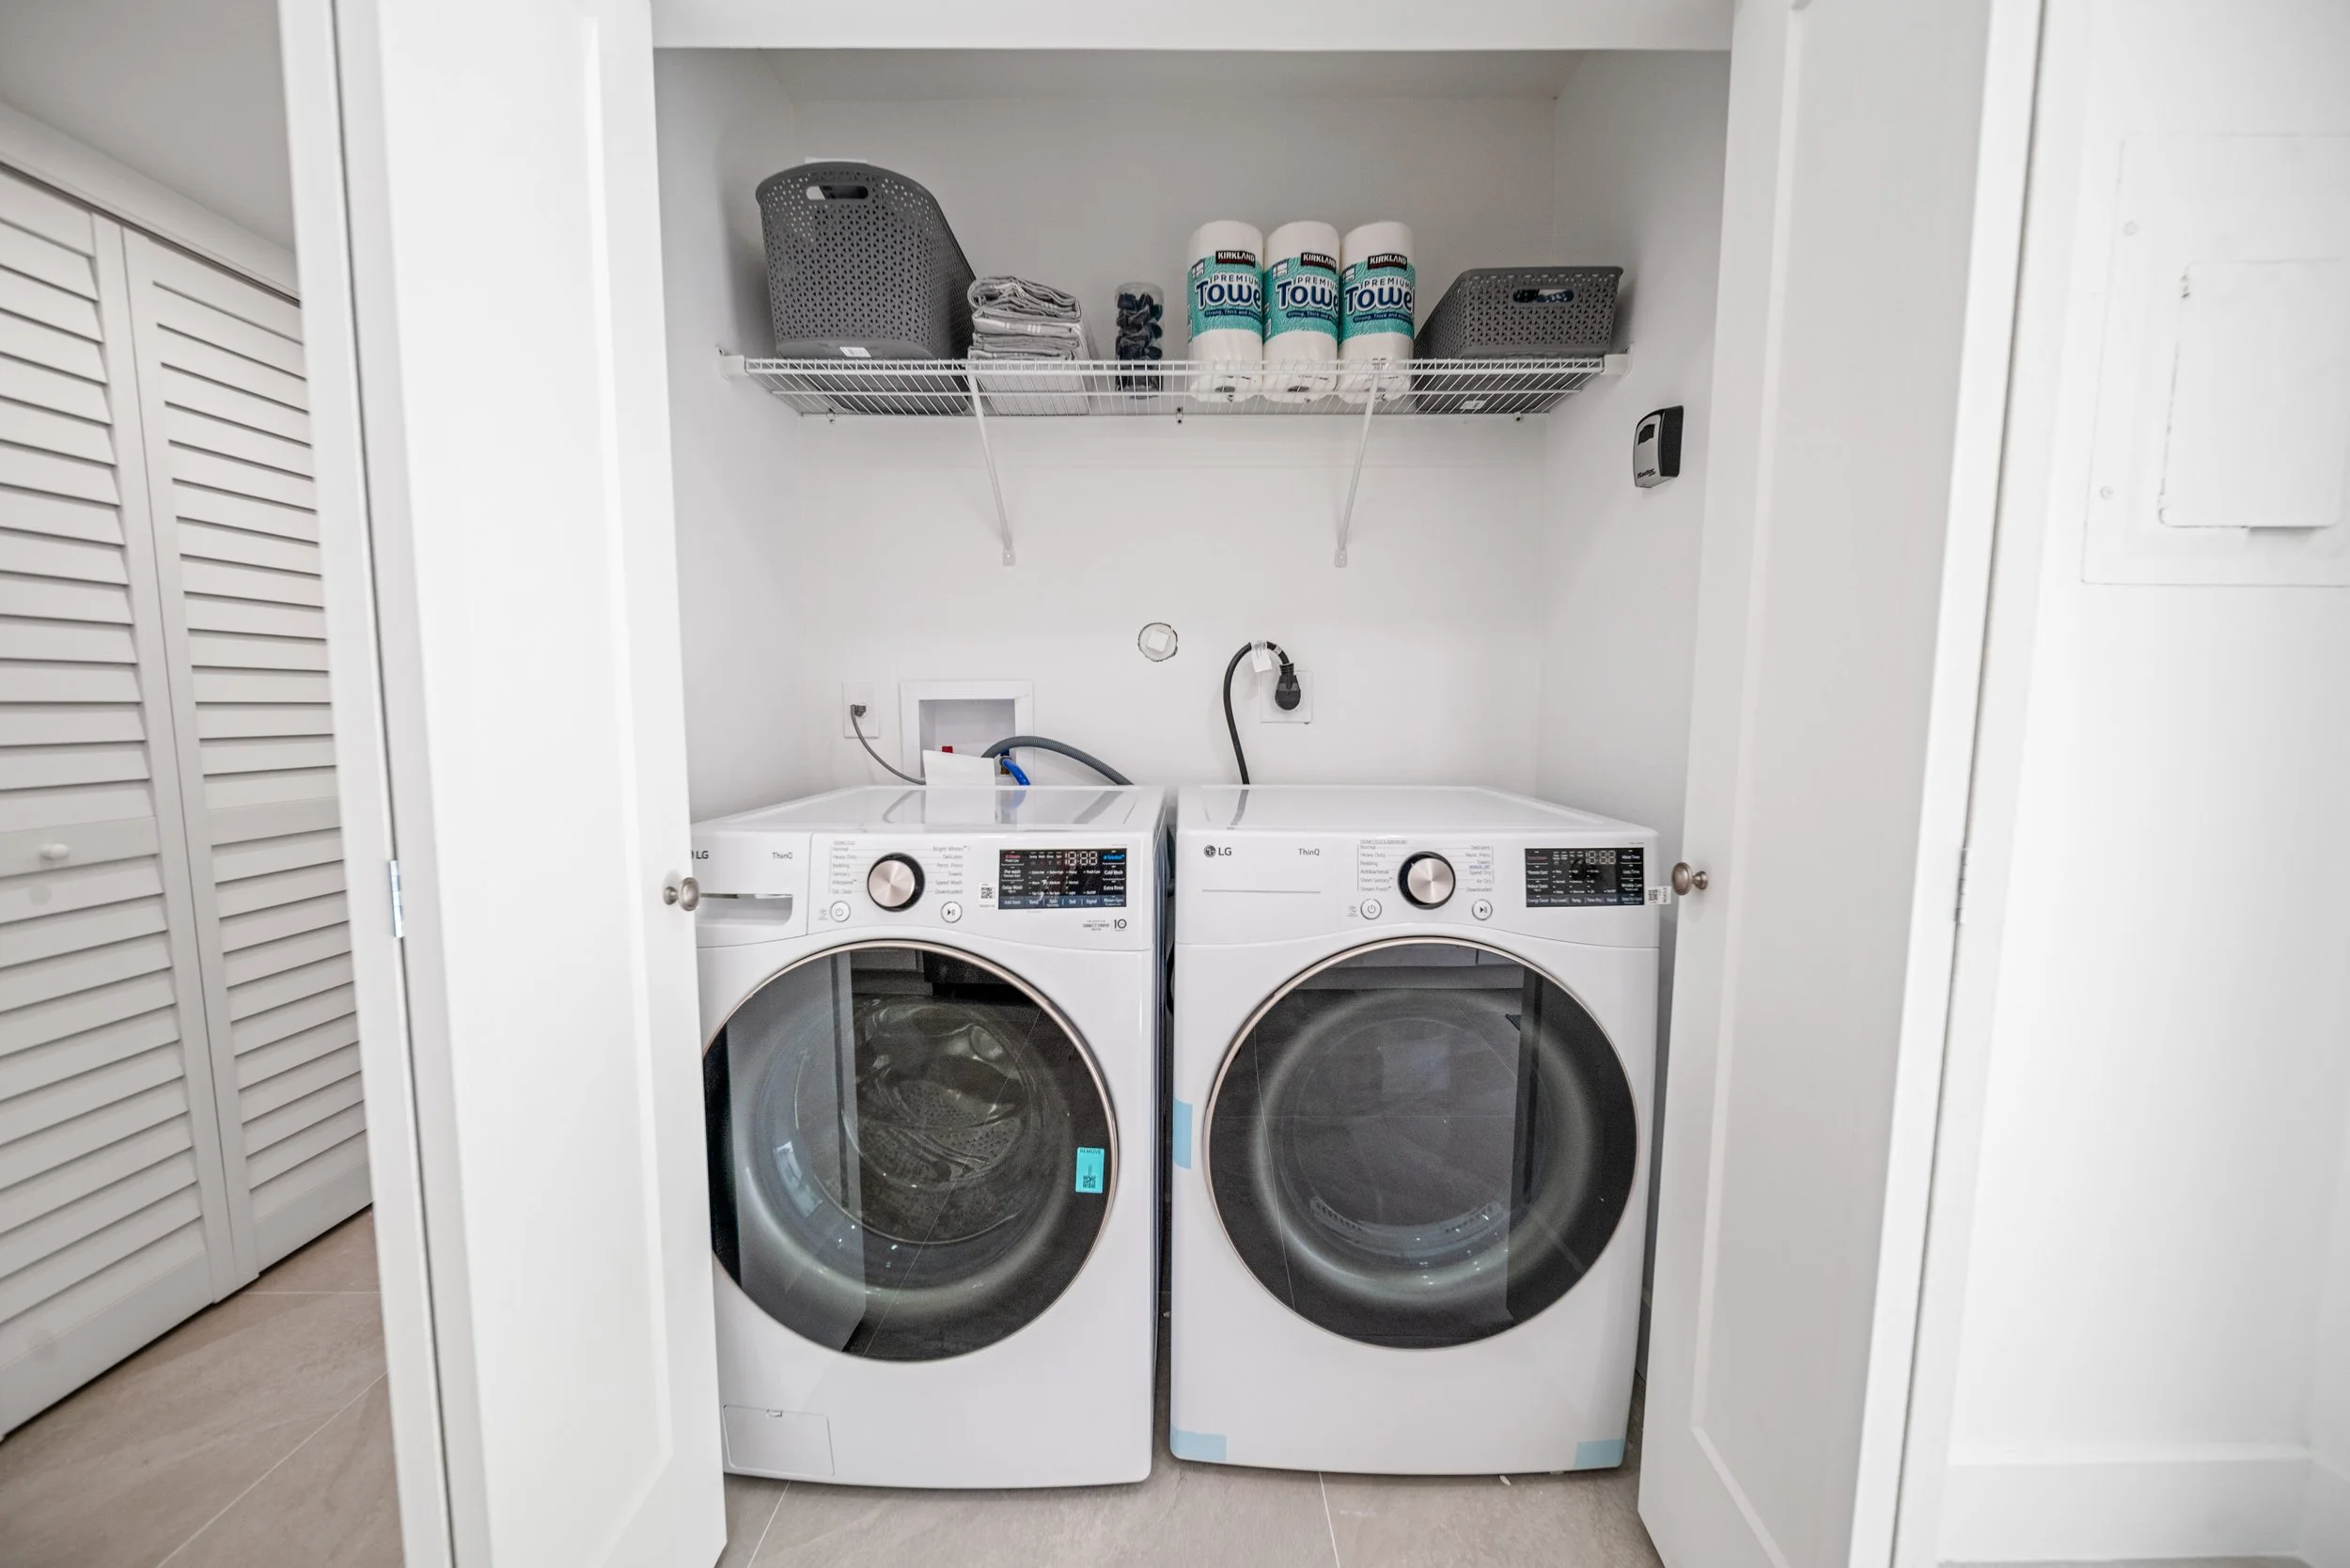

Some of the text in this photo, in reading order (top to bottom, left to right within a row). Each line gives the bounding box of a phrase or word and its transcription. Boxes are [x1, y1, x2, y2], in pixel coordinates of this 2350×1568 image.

[1217, 251, 1255, 262] KIRKLAND
[1303, 253, 1336, 268] KIRKLAND
[1370, 255, 1407, 265] KIRKLAND
[1345, 286, 1415, 313] Towe
[696, 851, 709, 859] LG
[1218, 847, 1232, 856] LG
